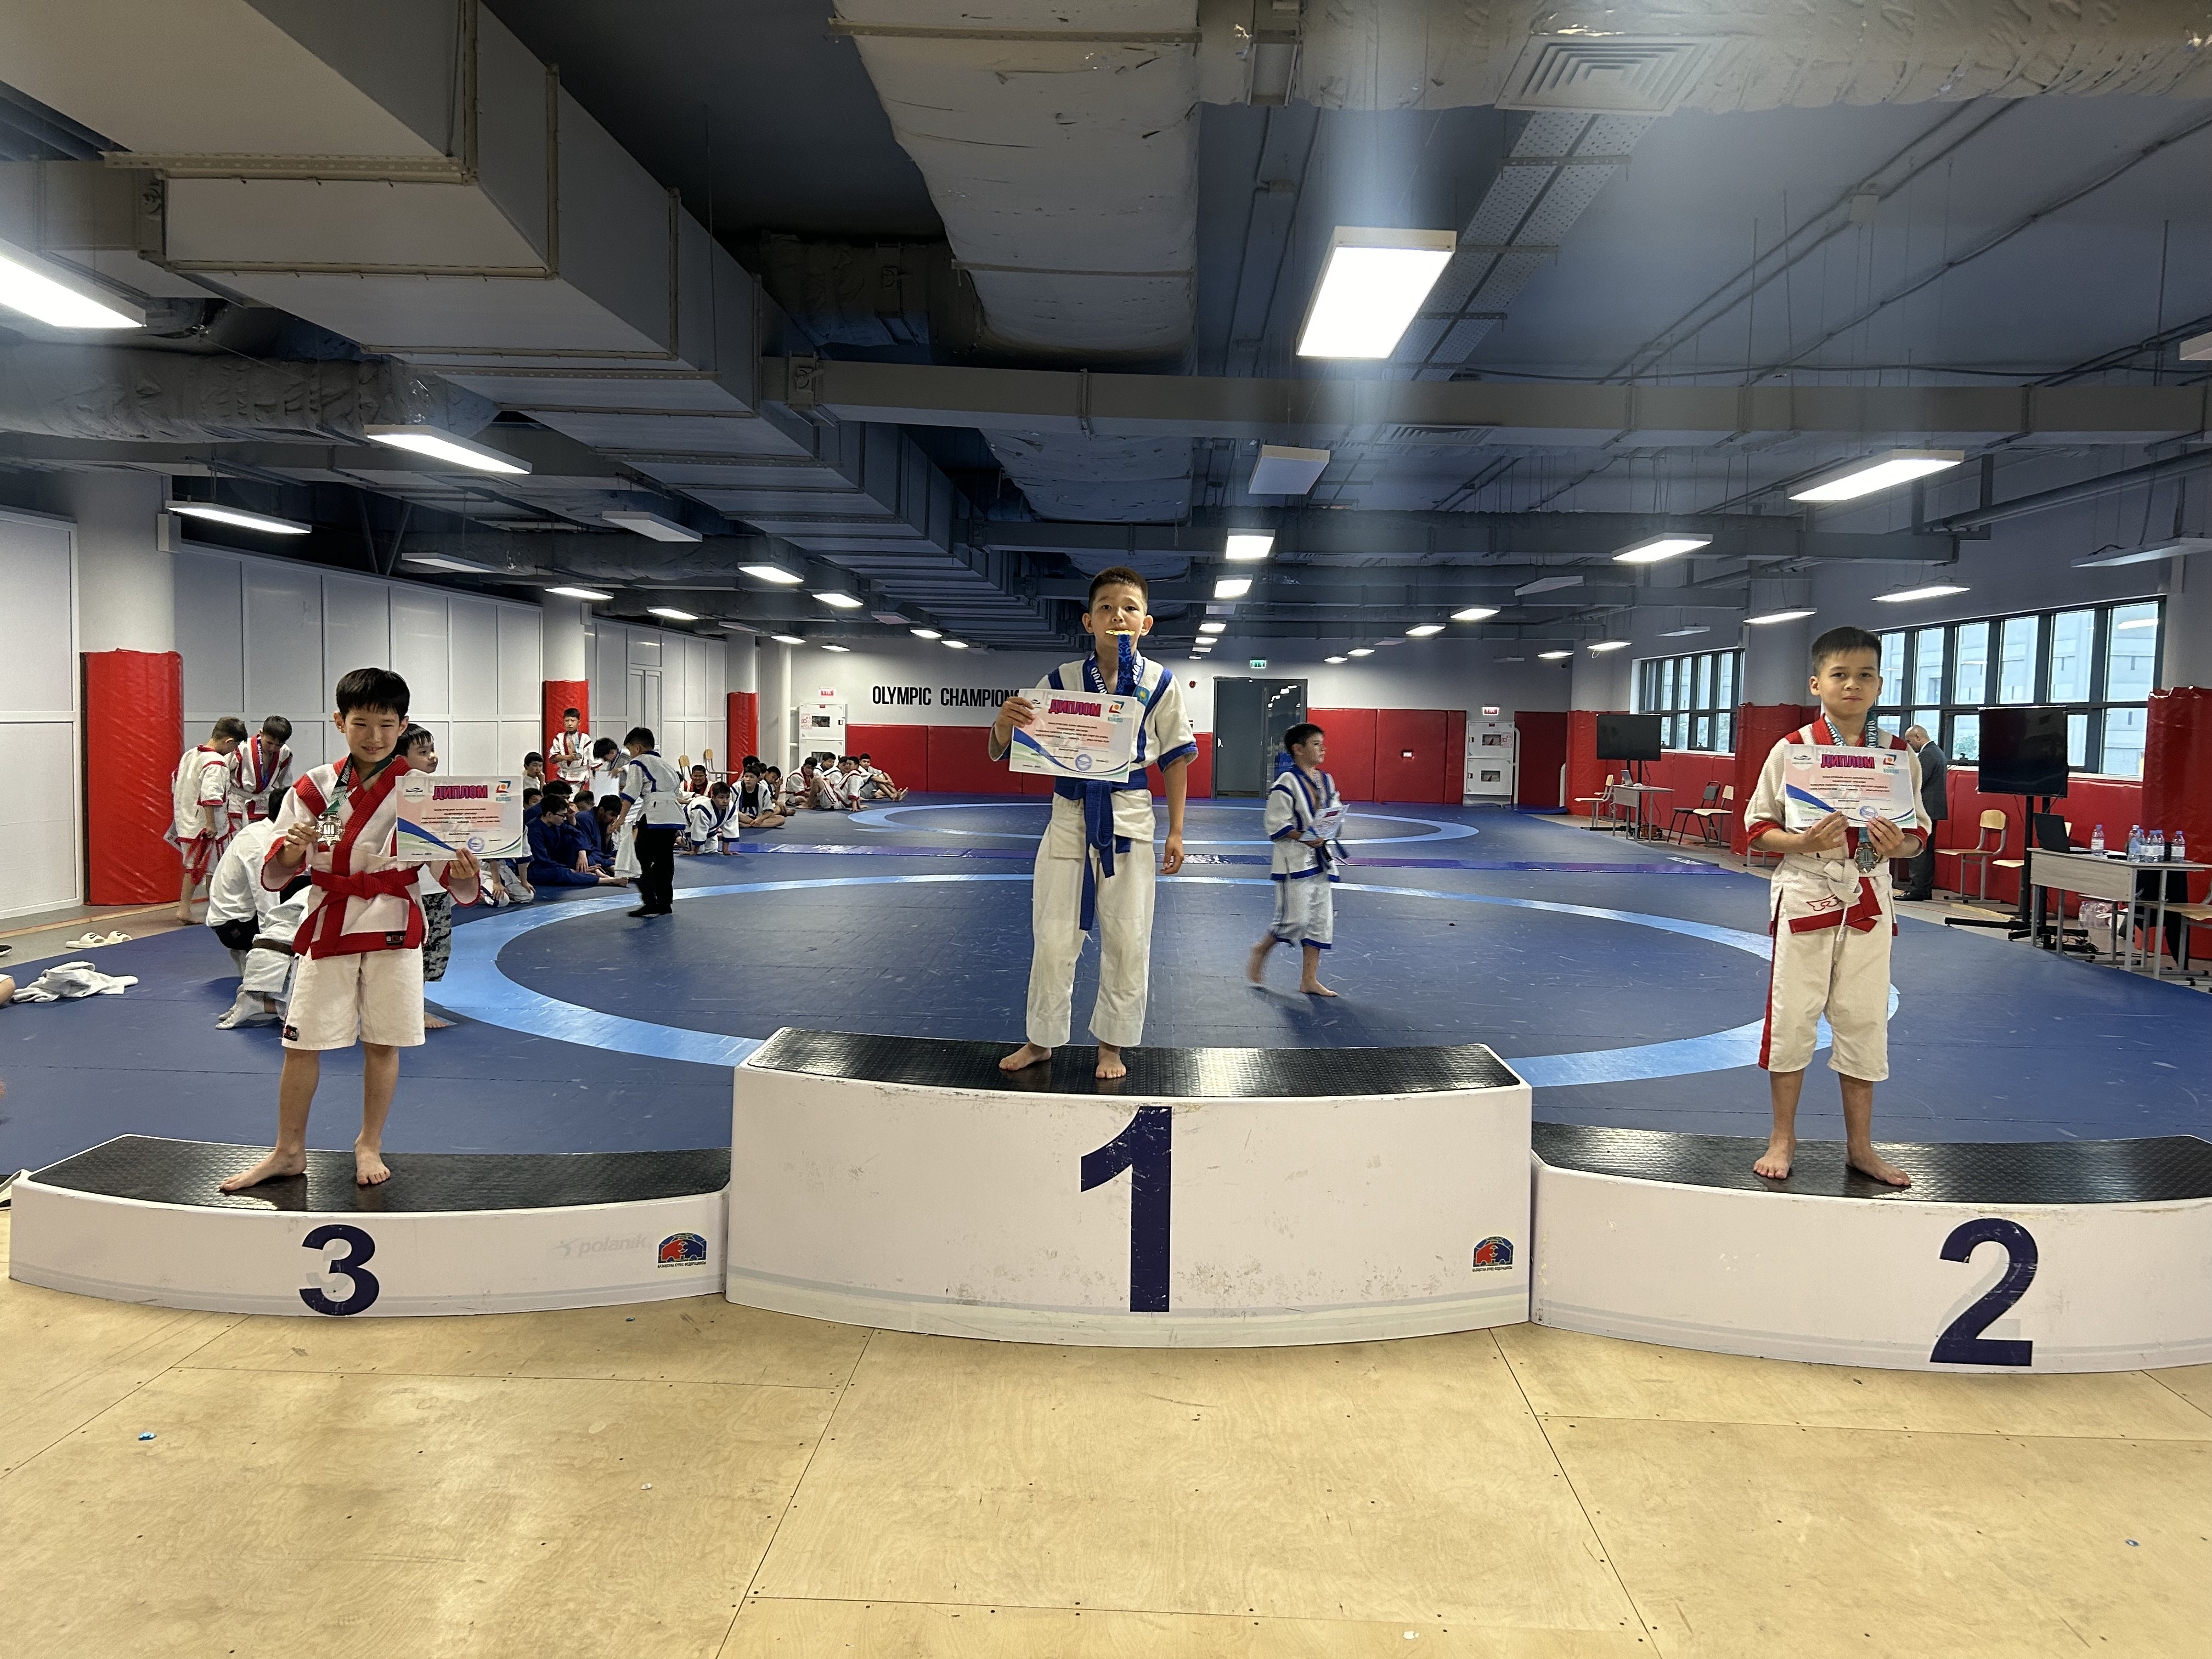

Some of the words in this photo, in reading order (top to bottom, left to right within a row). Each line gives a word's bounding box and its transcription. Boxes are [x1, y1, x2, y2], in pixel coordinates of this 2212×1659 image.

[872, 686, 932, 706] OLYMPIC
[940, 687, 1019, 708] CHAMPION
[1048, 698, 1102, 717] ДИПЛОМ
[1820, 754, 1875, 769] ДИПЛОМ
[432, 785, 488, 801] ДИПЛОМ
[1081, 1106, 1171, 1312] 1
[300, 1224, 379, 1316] 3
[1929, 1218, 2038, 1366] 2
